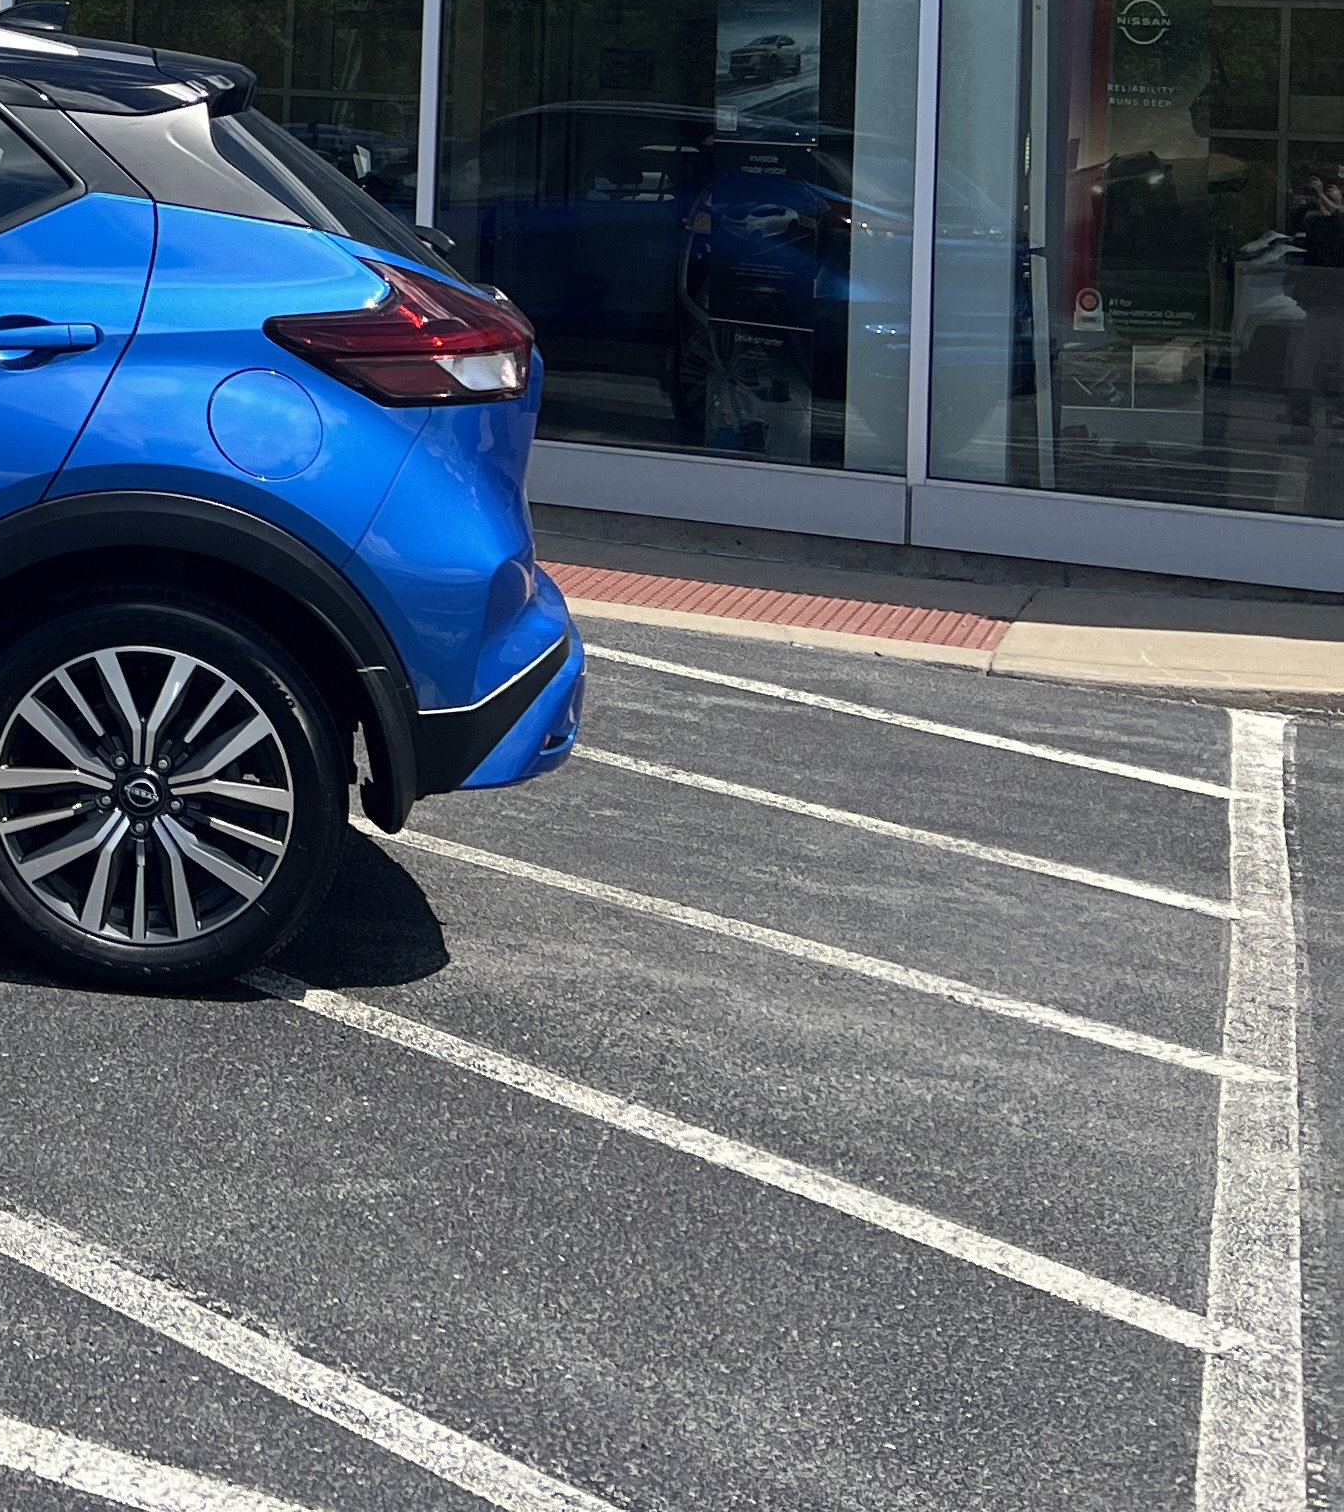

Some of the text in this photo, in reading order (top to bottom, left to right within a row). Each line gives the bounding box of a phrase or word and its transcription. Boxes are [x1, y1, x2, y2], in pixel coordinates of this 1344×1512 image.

[1116, 16, 1171, 26] NISSAN
[1107, 84, 1175, 94] RELIABILITY
[1109, 97, 1172, 107] RUNS DEEP
